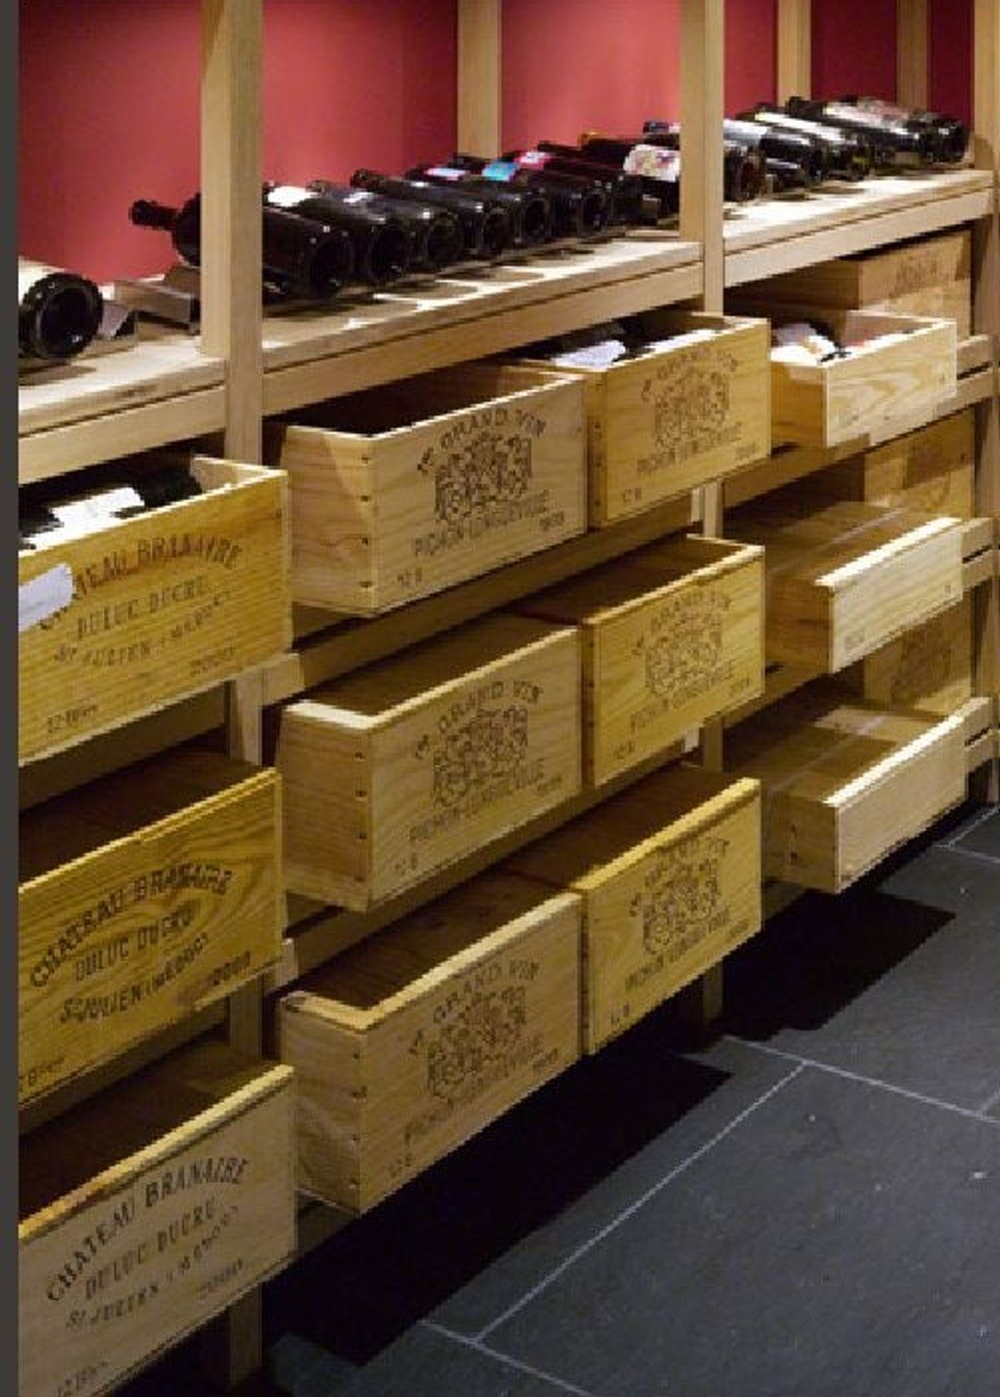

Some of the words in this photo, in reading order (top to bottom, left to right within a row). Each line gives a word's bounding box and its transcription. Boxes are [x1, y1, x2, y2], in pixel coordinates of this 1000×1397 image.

[45, 1194, 135, 1303] CHATEAU
[145, 1156, 250, 1209] BRANAIRE
[85, 1243, 148, 1301] DULUC
